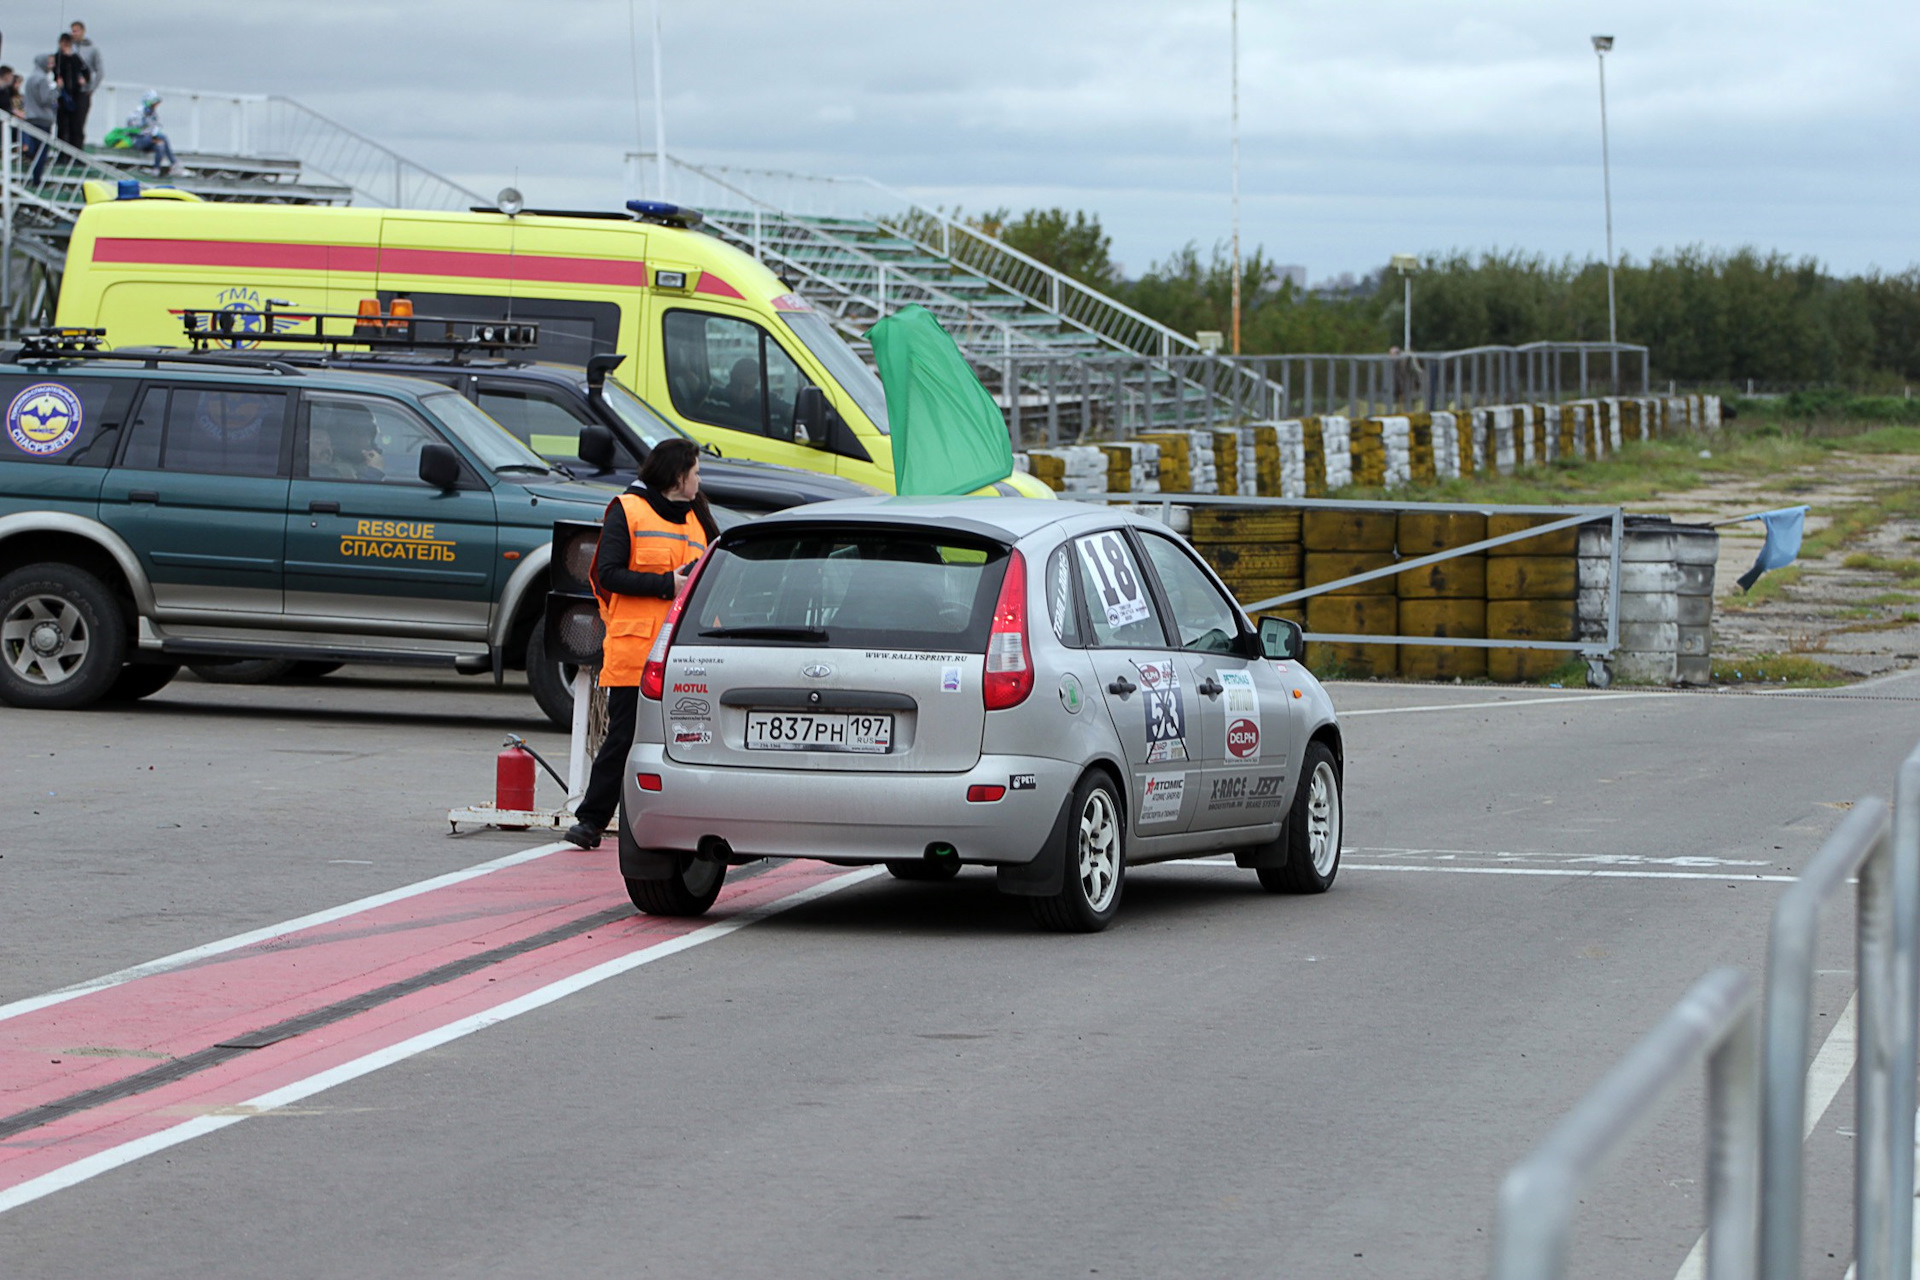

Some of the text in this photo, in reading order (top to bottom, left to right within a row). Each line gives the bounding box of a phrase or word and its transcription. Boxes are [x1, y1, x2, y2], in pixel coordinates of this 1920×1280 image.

[12, 428, 74, 453] СПАСРЕЗЕРВ
[357, 520, 435, 539] RESCUE
[340, 540, 456, 561] СПАСАТЕЛЬ
[1084, 536, 1137, 606] 18
[865, 652, 967, 662] WWW.RALLYSPRINT.RU
[673, 683, 708, 693] MOTUL
[1223, 674, 1249, 685] PETRONAS
[1150, 690, 1179, 739] 53
[850, 717, 884, 736] 197
[1229, 732, 1256, 744] DELPHI
[1153, 779, 1184, 791] ATOMIC
[1249, 775, 1285, 796] JBT
